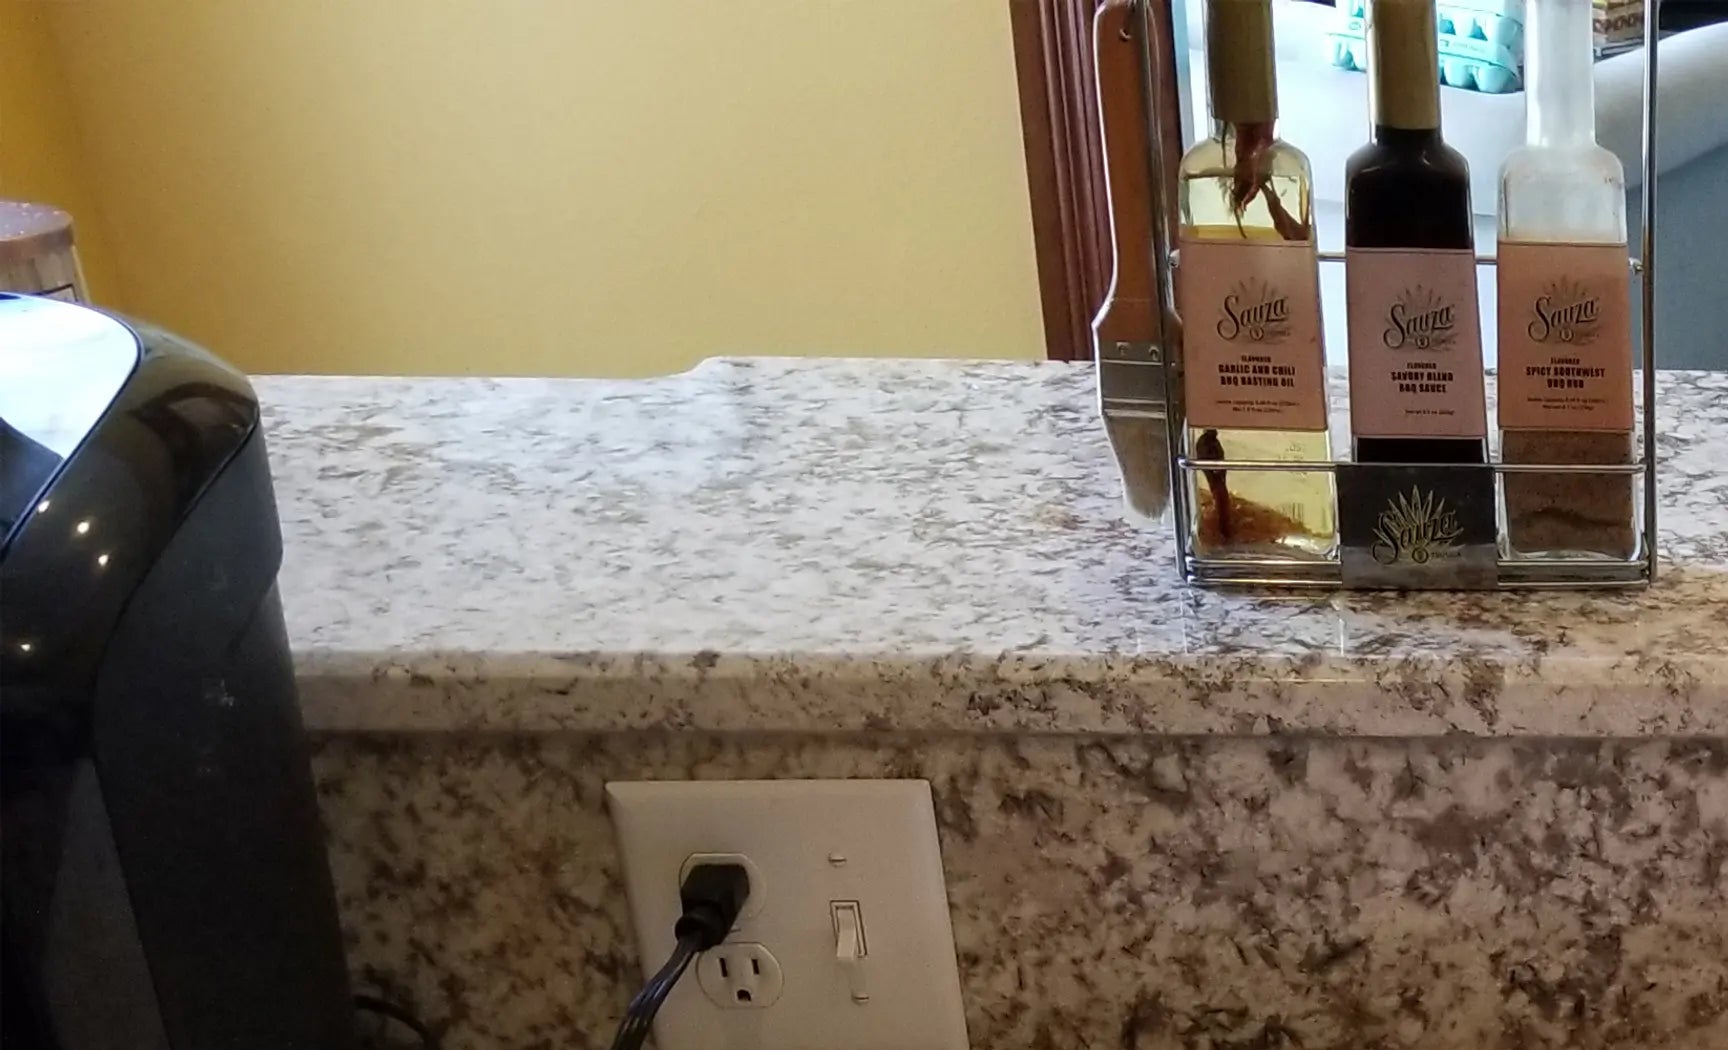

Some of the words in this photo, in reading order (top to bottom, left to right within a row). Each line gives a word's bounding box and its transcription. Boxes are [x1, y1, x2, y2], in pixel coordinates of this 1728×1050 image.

[1218, 364, 1250, 374] GARLIC
[1252, 365, 1270, 374] AND
[1272, 366, 1296, 376] CHILI
[1526, 366, 1552, 376] SPICY
[1553, 366, 1606, 378] SOUTHWEST
[1391, 371, 1424, 381] SAVORY
[1281, 378, 1295, 387] OIL
[1399, 383, 1417, 393] BBQ
[1419, 383, 1447, 393] SAUCE
